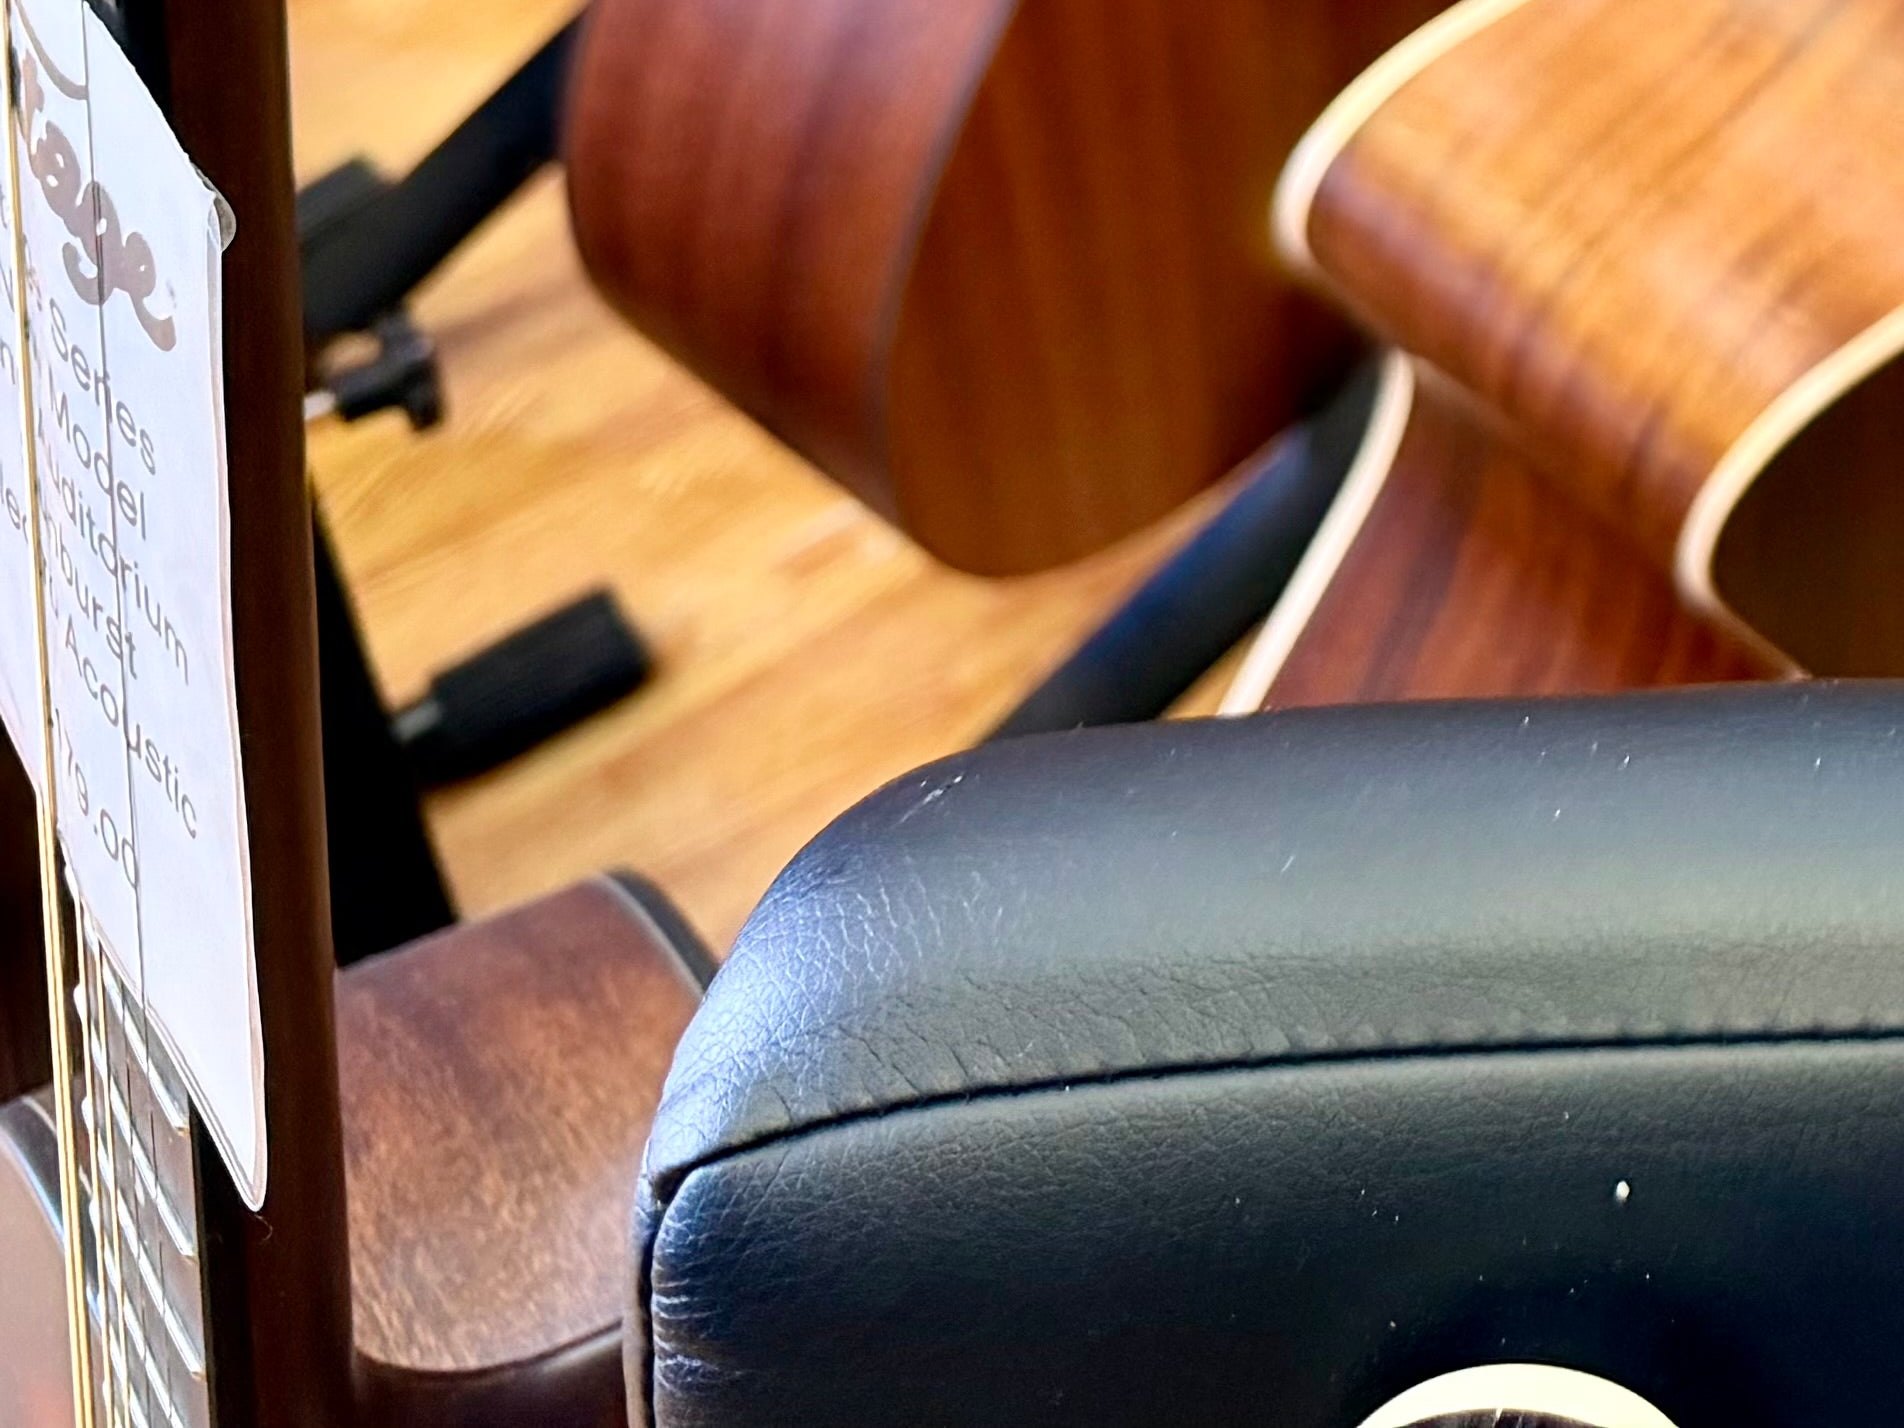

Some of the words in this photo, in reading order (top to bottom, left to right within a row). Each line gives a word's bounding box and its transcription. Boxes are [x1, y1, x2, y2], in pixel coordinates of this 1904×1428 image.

[48, 362, 147, 540] Model
[50, 297, 156, 476] Series
[65, 613, 197, 840] Acoustic
